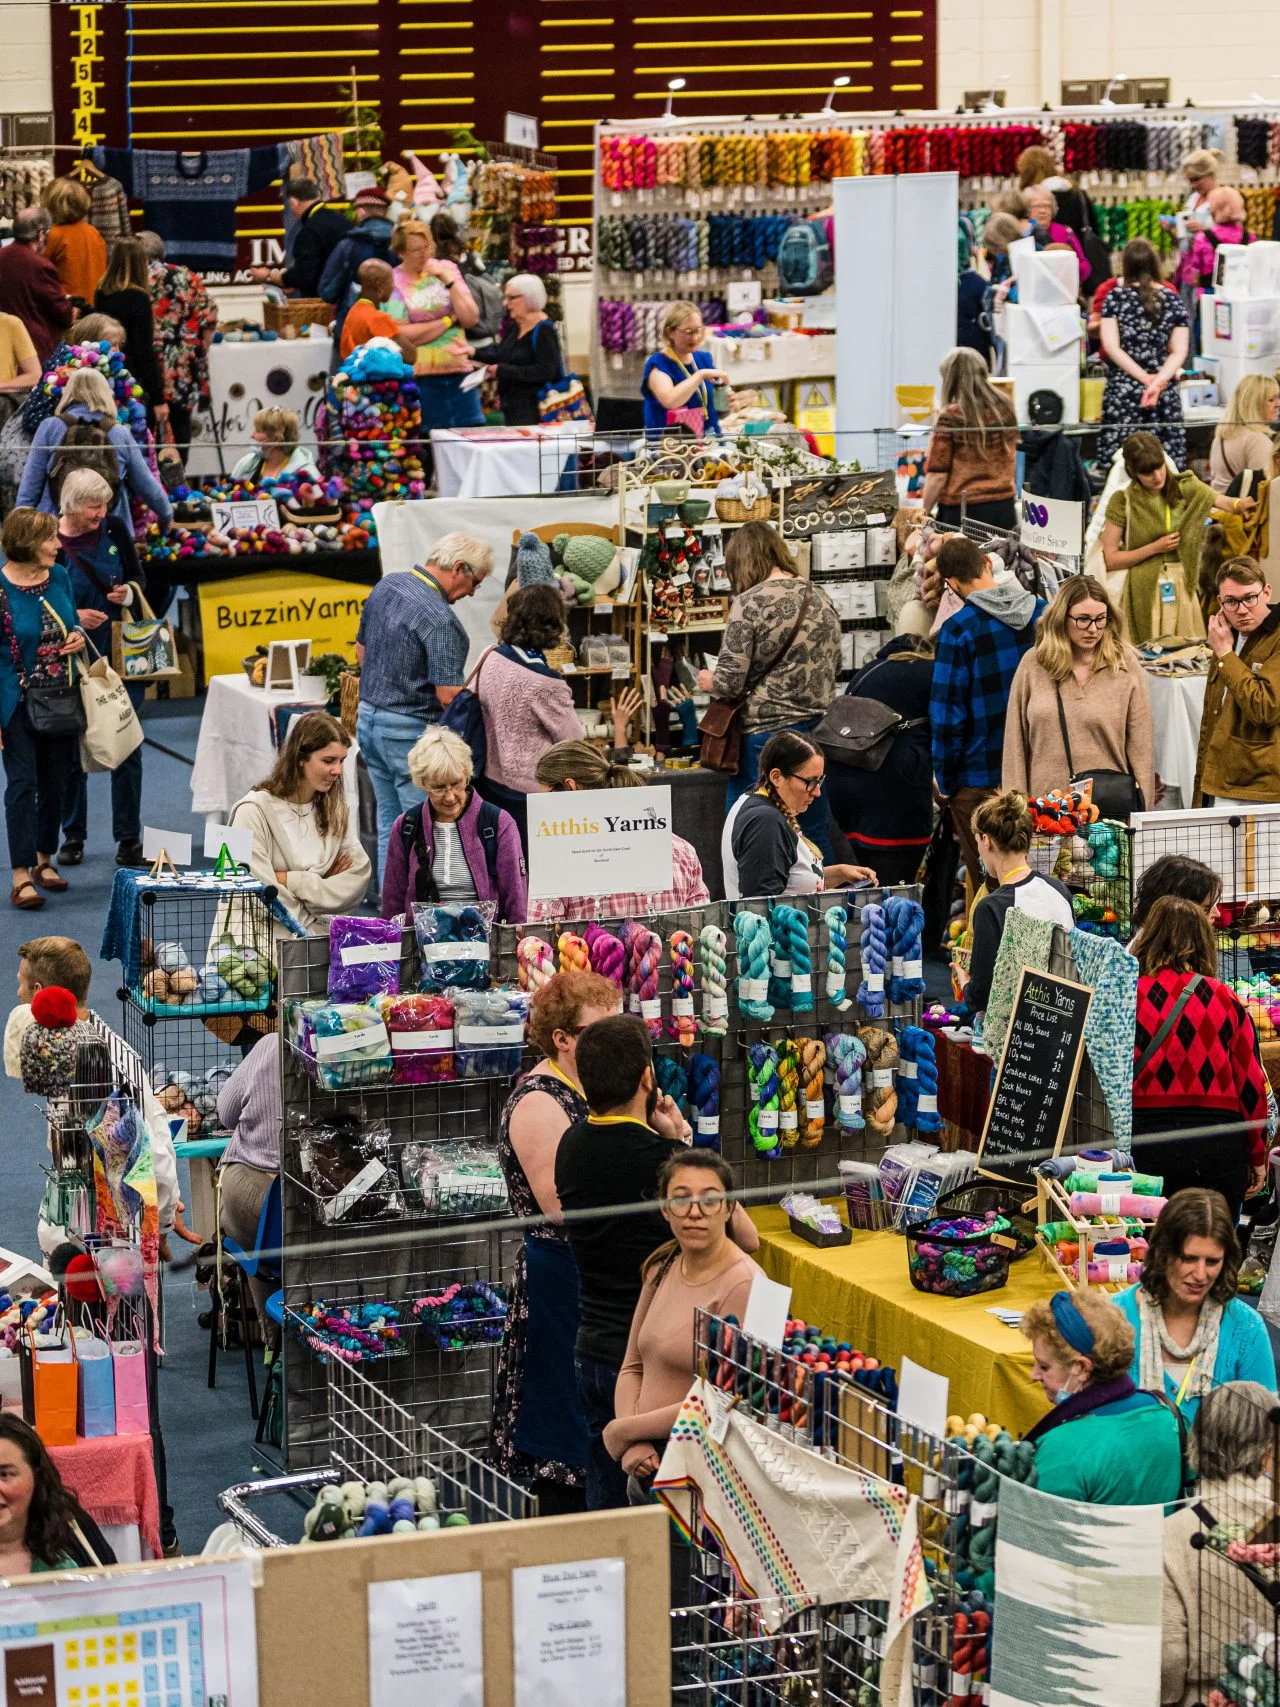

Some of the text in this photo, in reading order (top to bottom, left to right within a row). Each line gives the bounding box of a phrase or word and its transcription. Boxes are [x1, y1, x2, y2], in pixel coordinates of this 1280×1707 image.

[84, 12, 92, 28] 1
[83, 38, 93, 54] 2
[79, 64, 89, 80] 5
[83, 90, 93, 106] 3
[78, 116, 88, 132] 4
[536, 816, 667, 837] Atthis Yarns
[1024, 981, 1076, 1011] Atthis Yarns
[1030, 1006, 1058, 1023] Price List
[1013, 1019, 1022, 1030] All
[1004, 1063, 1027, 1079] Gradient
[1001, 1077, 1014, 1091] Sock
